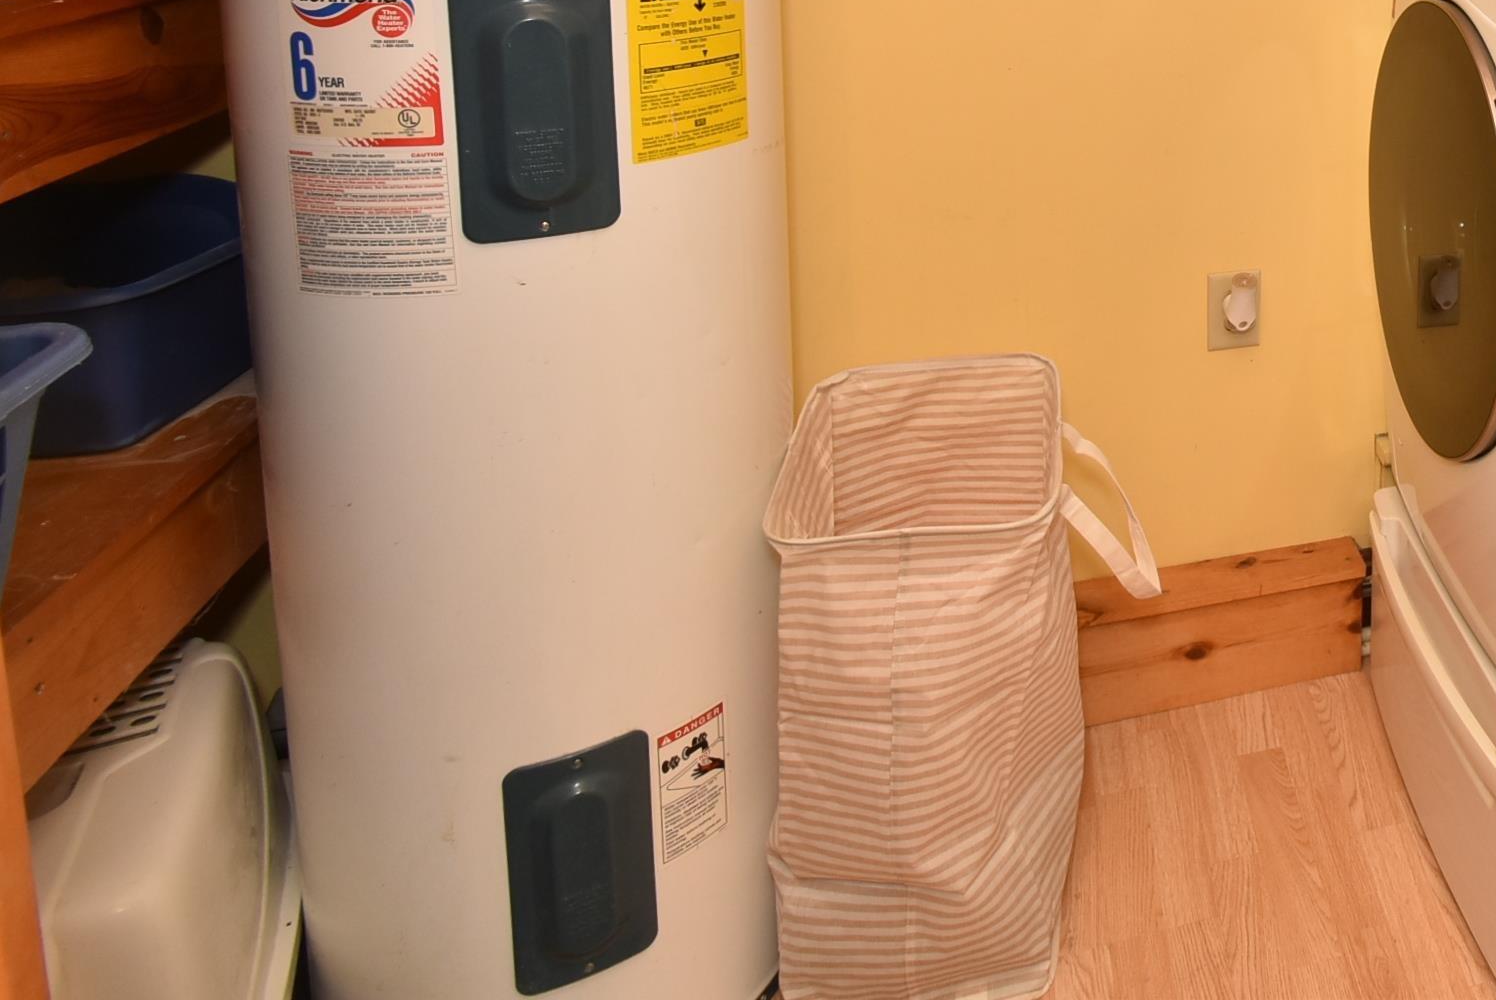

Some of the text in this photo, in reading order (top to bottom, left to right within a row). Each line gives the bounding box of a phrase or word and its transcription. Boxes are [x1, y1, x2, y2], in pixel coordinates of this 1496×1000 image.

[290, 31, 317, 101] 6
[318, 76, 345, 88] YEAR
[674, 706, 721, 740] DANGER
